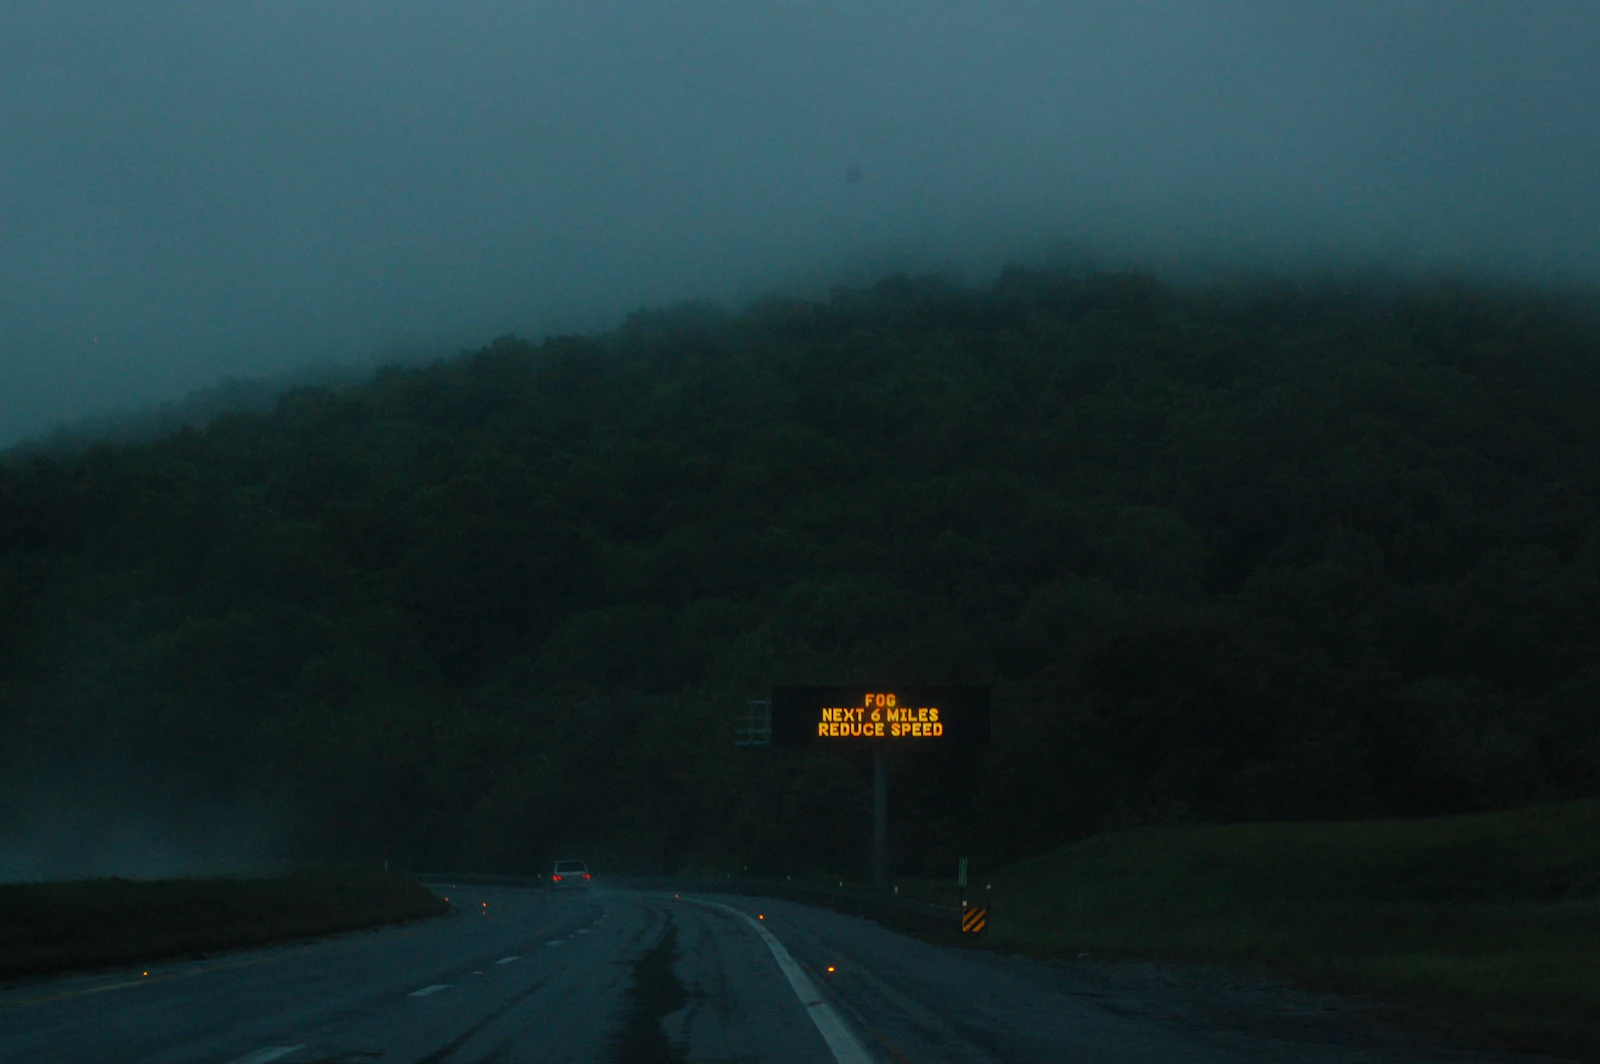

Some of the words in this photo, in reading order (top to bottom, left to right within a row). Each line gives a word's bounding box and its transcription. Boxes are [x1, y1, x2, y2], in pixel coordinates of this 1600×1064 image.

[865, 693, 896, 707] FOG
[822, 708, 864, 722] NEXT
[870, 708, 881, 722] 6
[887, 708, 939, 722] MILES
[818, 722, 885, 736] REDUCE
[890, 722, 943, 736] SPEED
